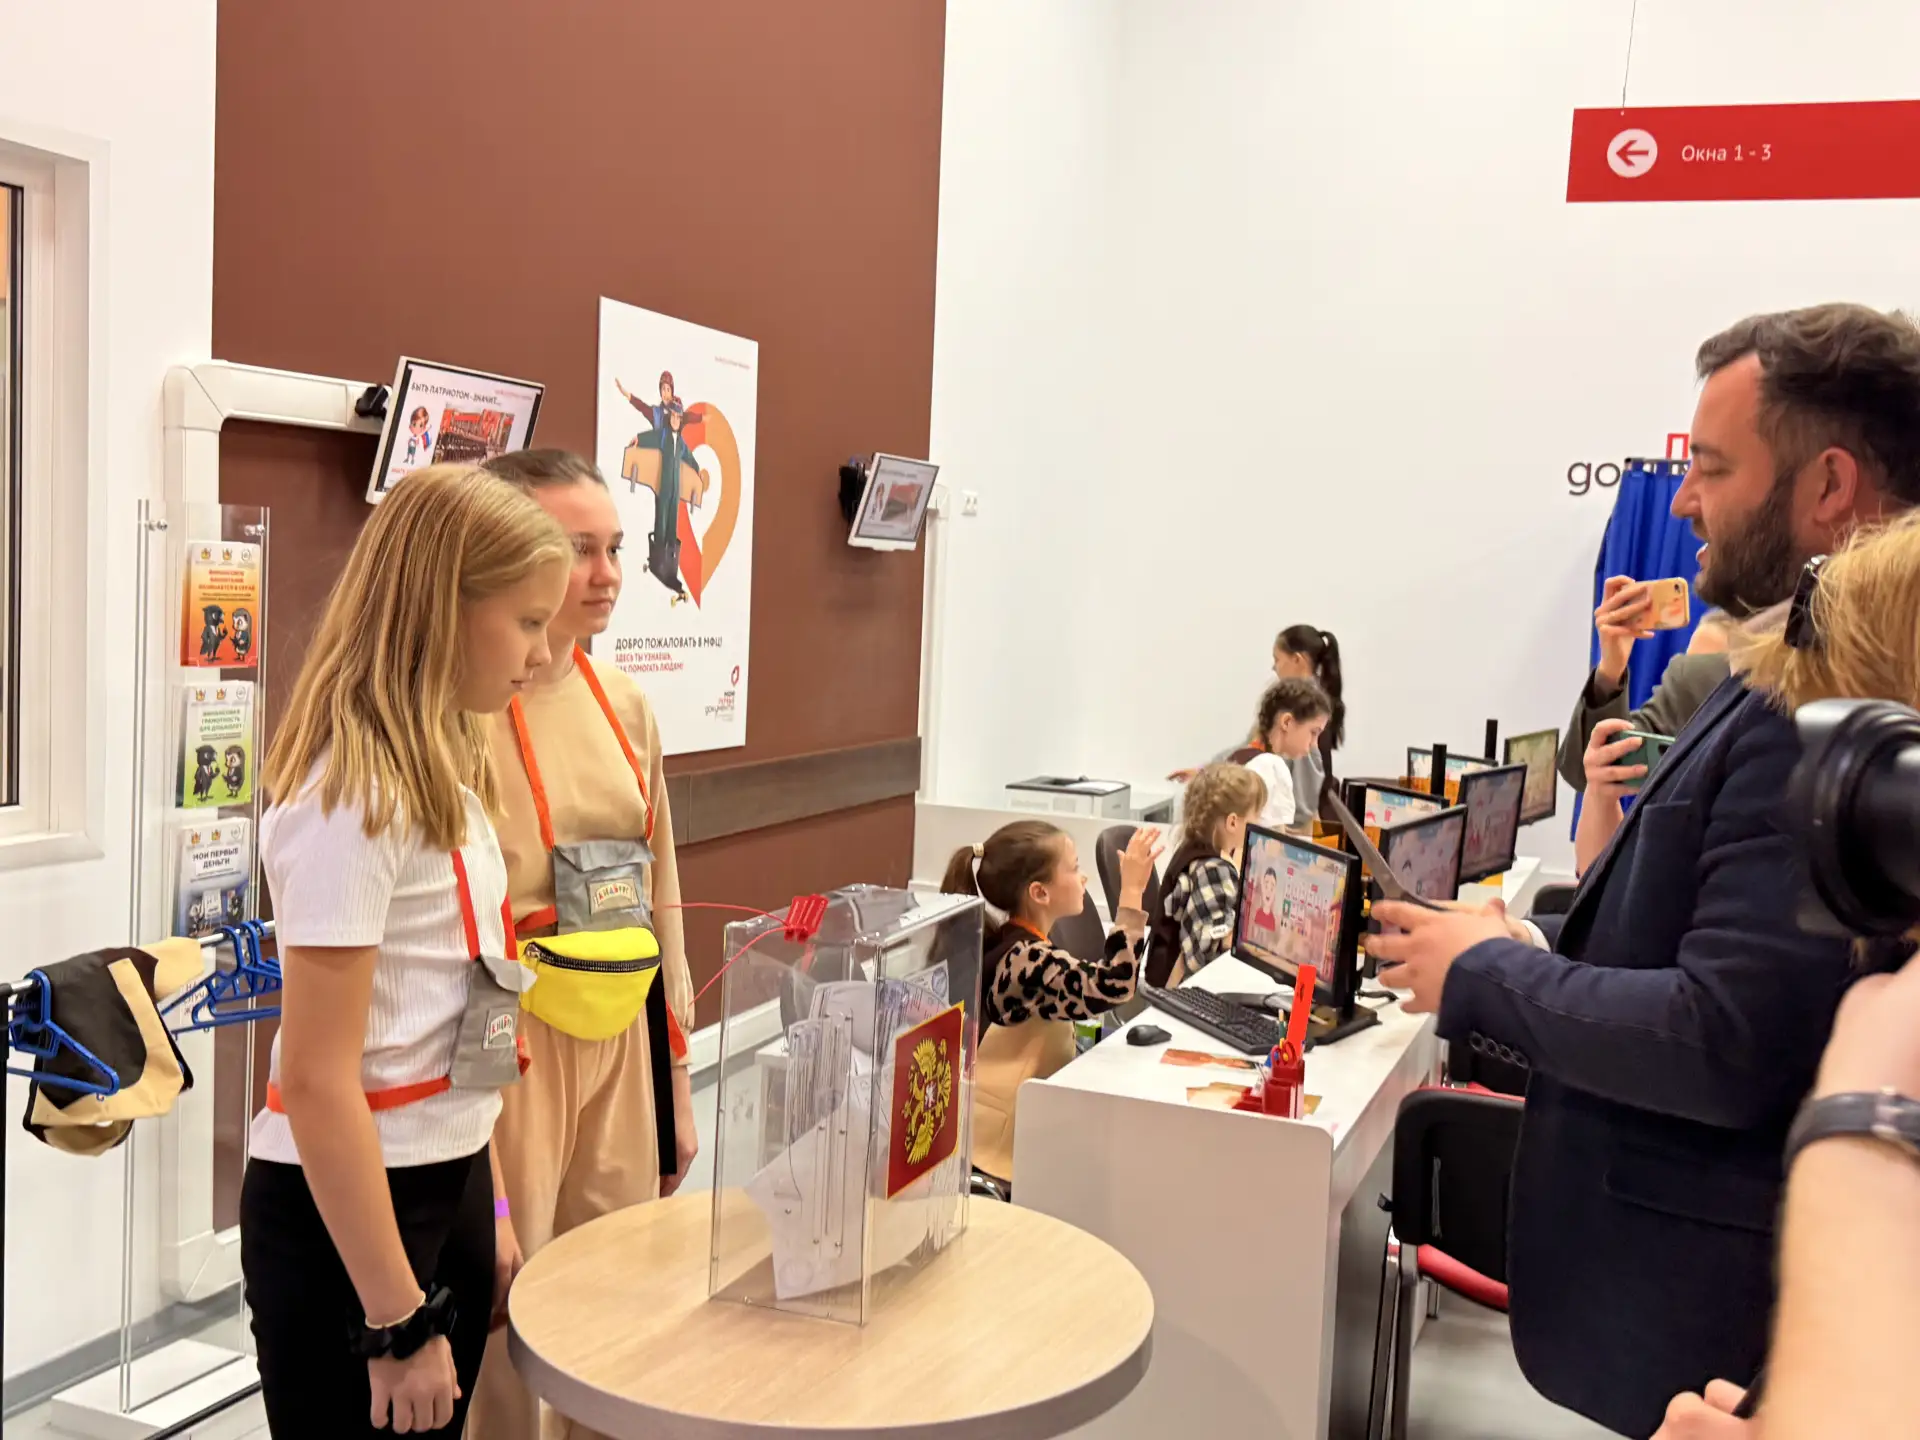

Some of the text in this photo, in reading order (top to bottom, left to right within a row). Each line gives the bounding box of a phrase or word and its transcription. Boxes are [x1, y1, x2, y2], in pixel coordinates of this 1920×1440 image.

[1682, 144, 1727, 162] Окна
[1734, 144, 1743, 161] 1
[1761, 144, 1771, 162] 3
[411, 382, 429, 392] БЫТЬ
[430, 384, 470, 400] ПАТРИОТОМ
[615, 638, 644, 651] ДОБРО
[645, 637, 697, 649] ПОЖАЛОВАТЬ
[703, 636, 723, 648] МФЦ!
[615, 653, 634, 663] ЗДЕСЬ
[635, 653, 643, 662] ТЫ
[628, 663, 659, 673] ПОМОГАТЬ
[192, 848, 238, 861] МОИ ПЕРВЫЕ
[203, 858, 230, 869] ДЕНЬГИ
